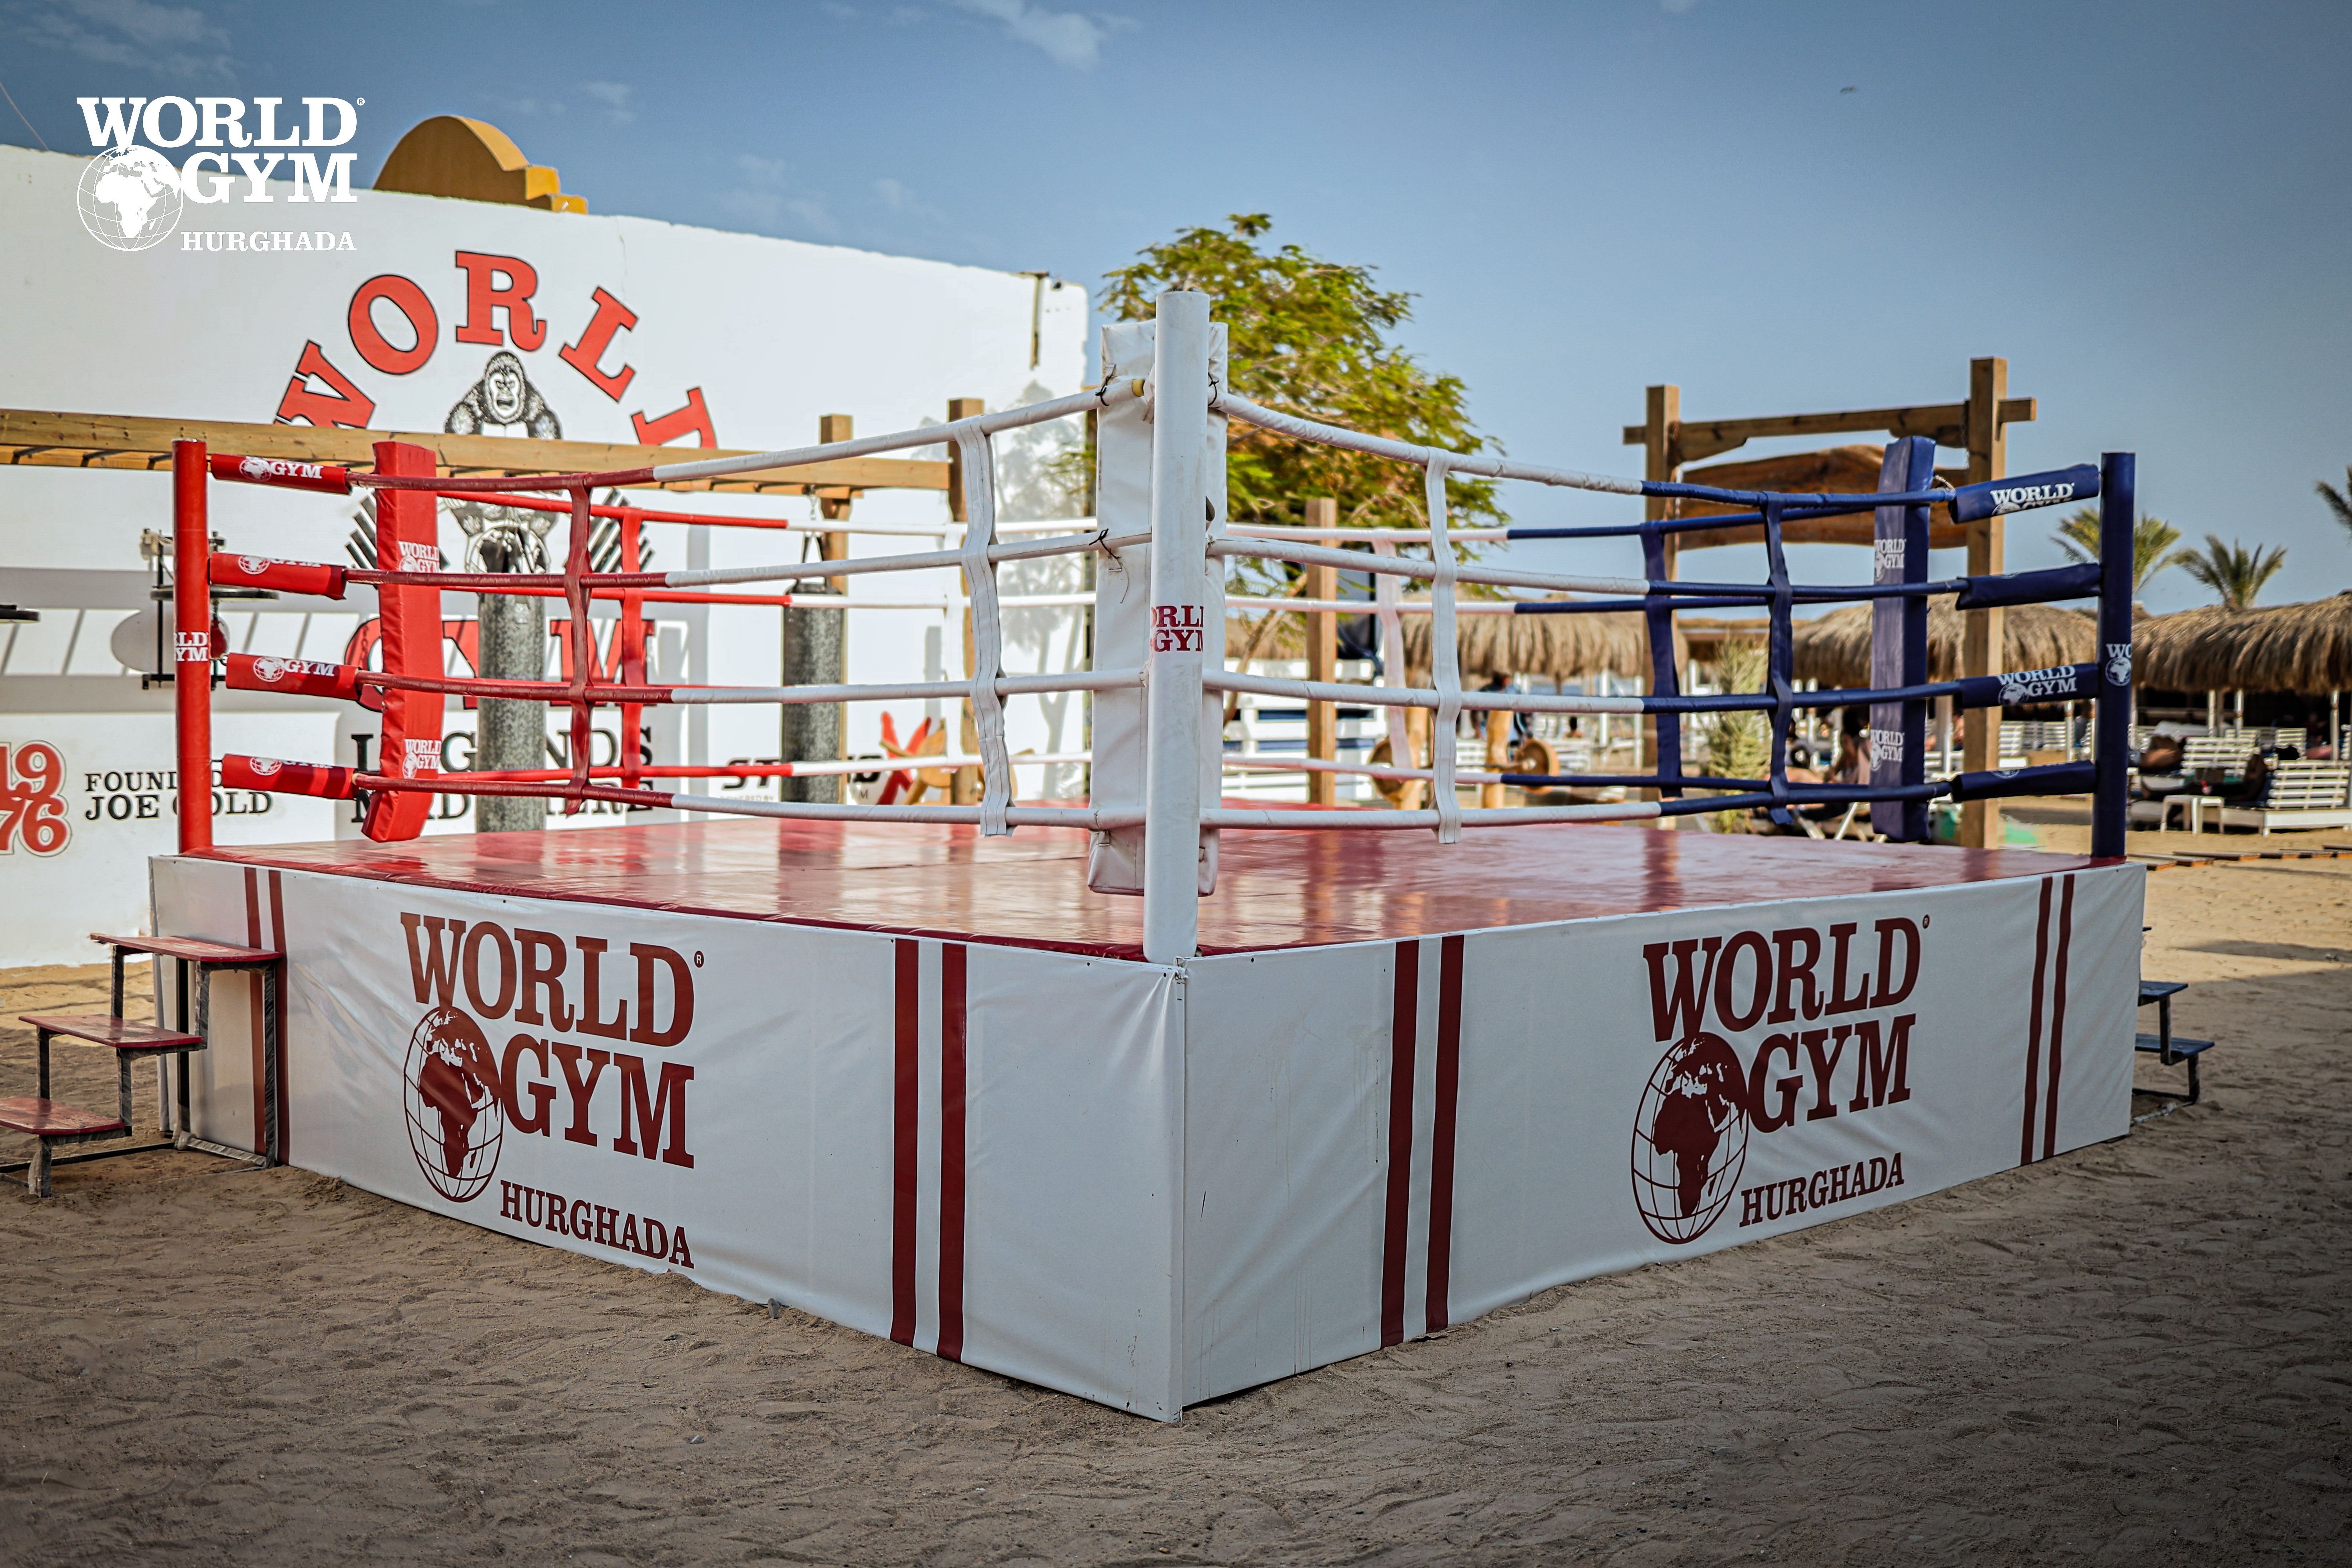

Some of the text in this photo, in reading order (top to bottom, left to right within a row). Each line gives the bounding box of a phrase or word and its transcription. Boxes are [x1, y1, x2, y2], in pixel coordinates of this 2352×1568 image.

[270, 461, 324, 479] GYM
[1990, 483, 2074, 505] WORLD
[283, 659, 337, 677] GYM
[1996, 665, 2076, 686] WORLD
[2027, 677, 2077, 697] GYM
[404, 739, 442, 755] WORLD
[1881, 745, 1903, 762] GYM
[85, 794, 159, 820] JOE
[401, 912, 694, 1047] WORLD
[1643, 916, 1921, 1042] WORLD
[1748, 1013, 1916, 1133] GYM
[500, 1034, 694, 1169] GYM
[1739, 1152, 1904, 1227] HURGHADA
[500, 1180, 694, 1269] HURGHADA
